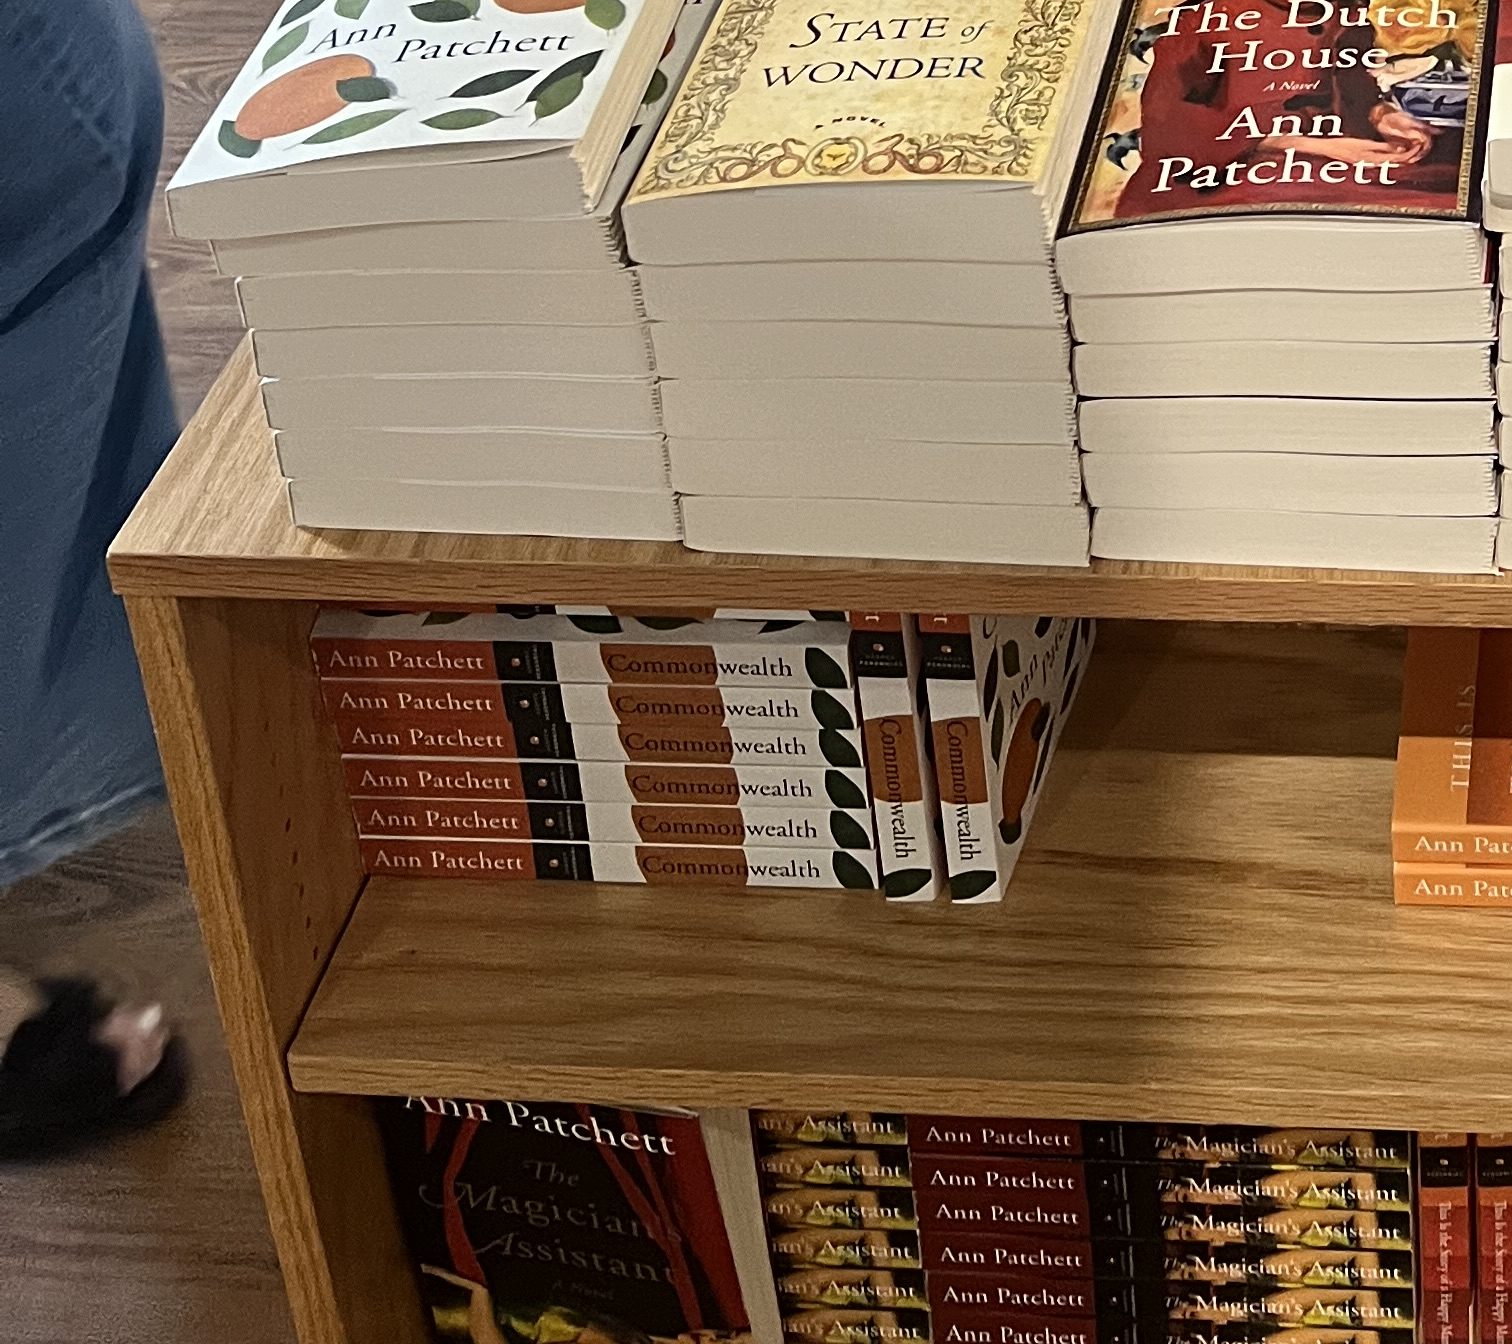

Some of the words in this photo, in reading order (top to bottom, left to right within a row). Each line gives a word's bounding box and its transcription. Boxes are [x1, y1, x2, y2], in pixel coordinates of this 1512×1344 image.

[960, 18, 994, 45] of
[1152, 4, 1263, 39] The
[308, 22, 397, 54] Ann
[393, 31, 575, 64] Patchett
[1205, 40, 1389, 75] House
[762, 56, 987, 88] WONDER
[1262, 82, 1277, 93] A
[1278, 79, 1320, 93] Novel
[829, 115, 890, 129] NOVEL
[1215, 105, 1344, 142] Ann
[1150, 148, 1401, 194] Patchett
[329, 649, 383, 670] Ann
[390, 648, 486, 671] Patchett
[607, 654, 794, 680] Commonwealth
[1414, 836, 1465, 853] Ann
[930, 1169, 977, 1188] Ann
[985, 1170, 1076, 1191] Patchett
[1189, 1179, 1299, 1199] Magician's
[1304, 1182, 1399, 1202] Assistant
